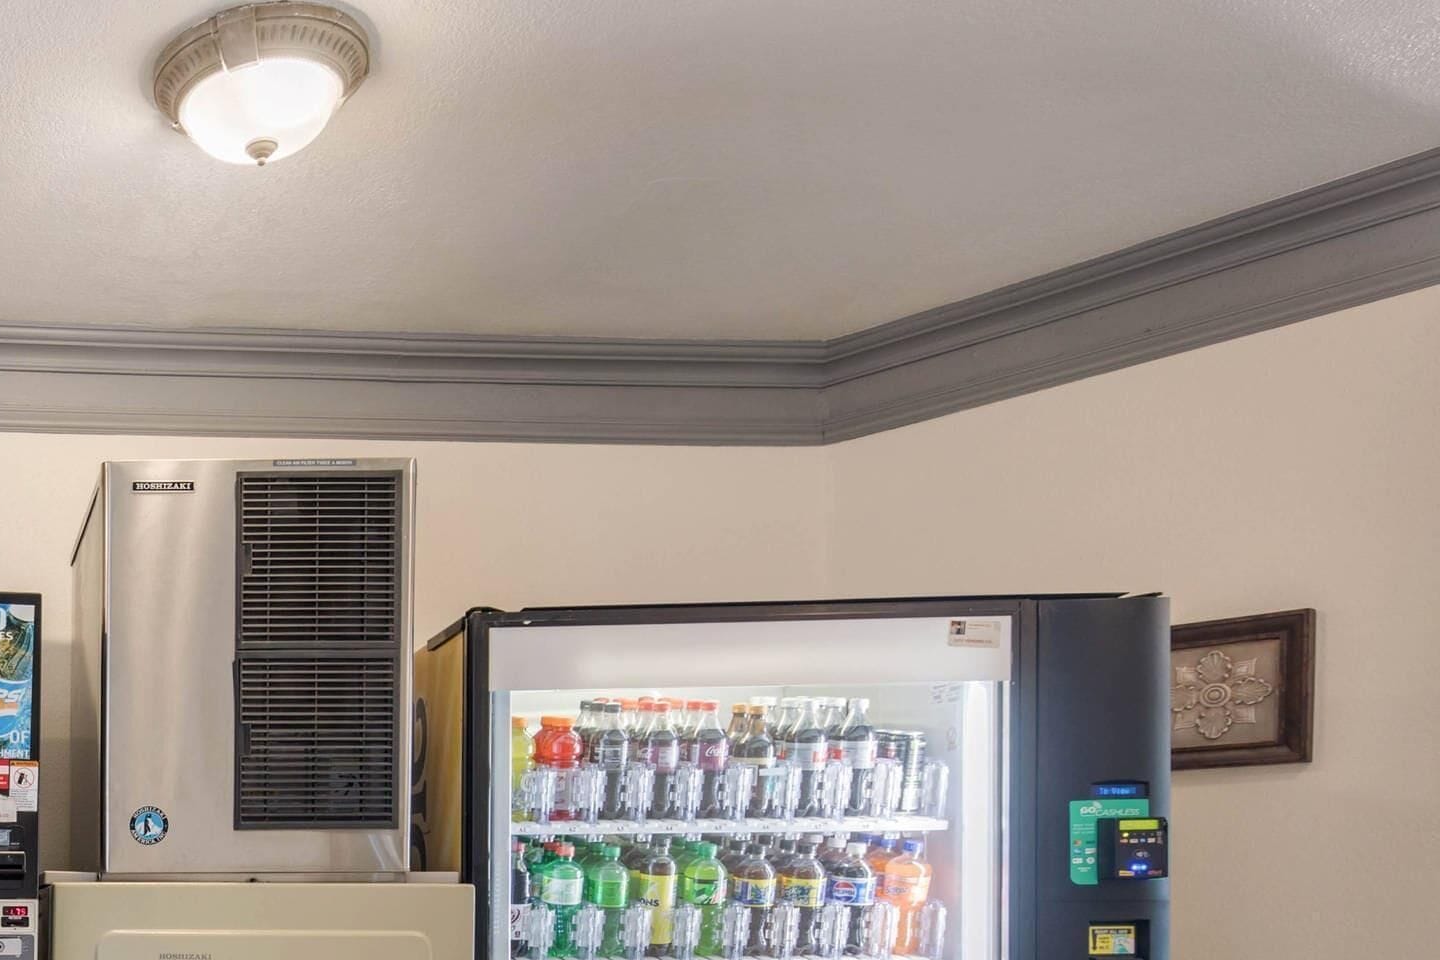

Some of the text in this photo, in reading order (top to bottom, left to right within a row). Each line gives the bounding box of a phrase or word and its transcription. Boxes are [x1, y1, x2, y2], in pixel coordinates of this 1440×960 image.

[135, 482, 192, 490] HOSHIZAKI
[10, 730, 30, 744] OF
[159, 953, 212, 960] HOSHIZAKI
